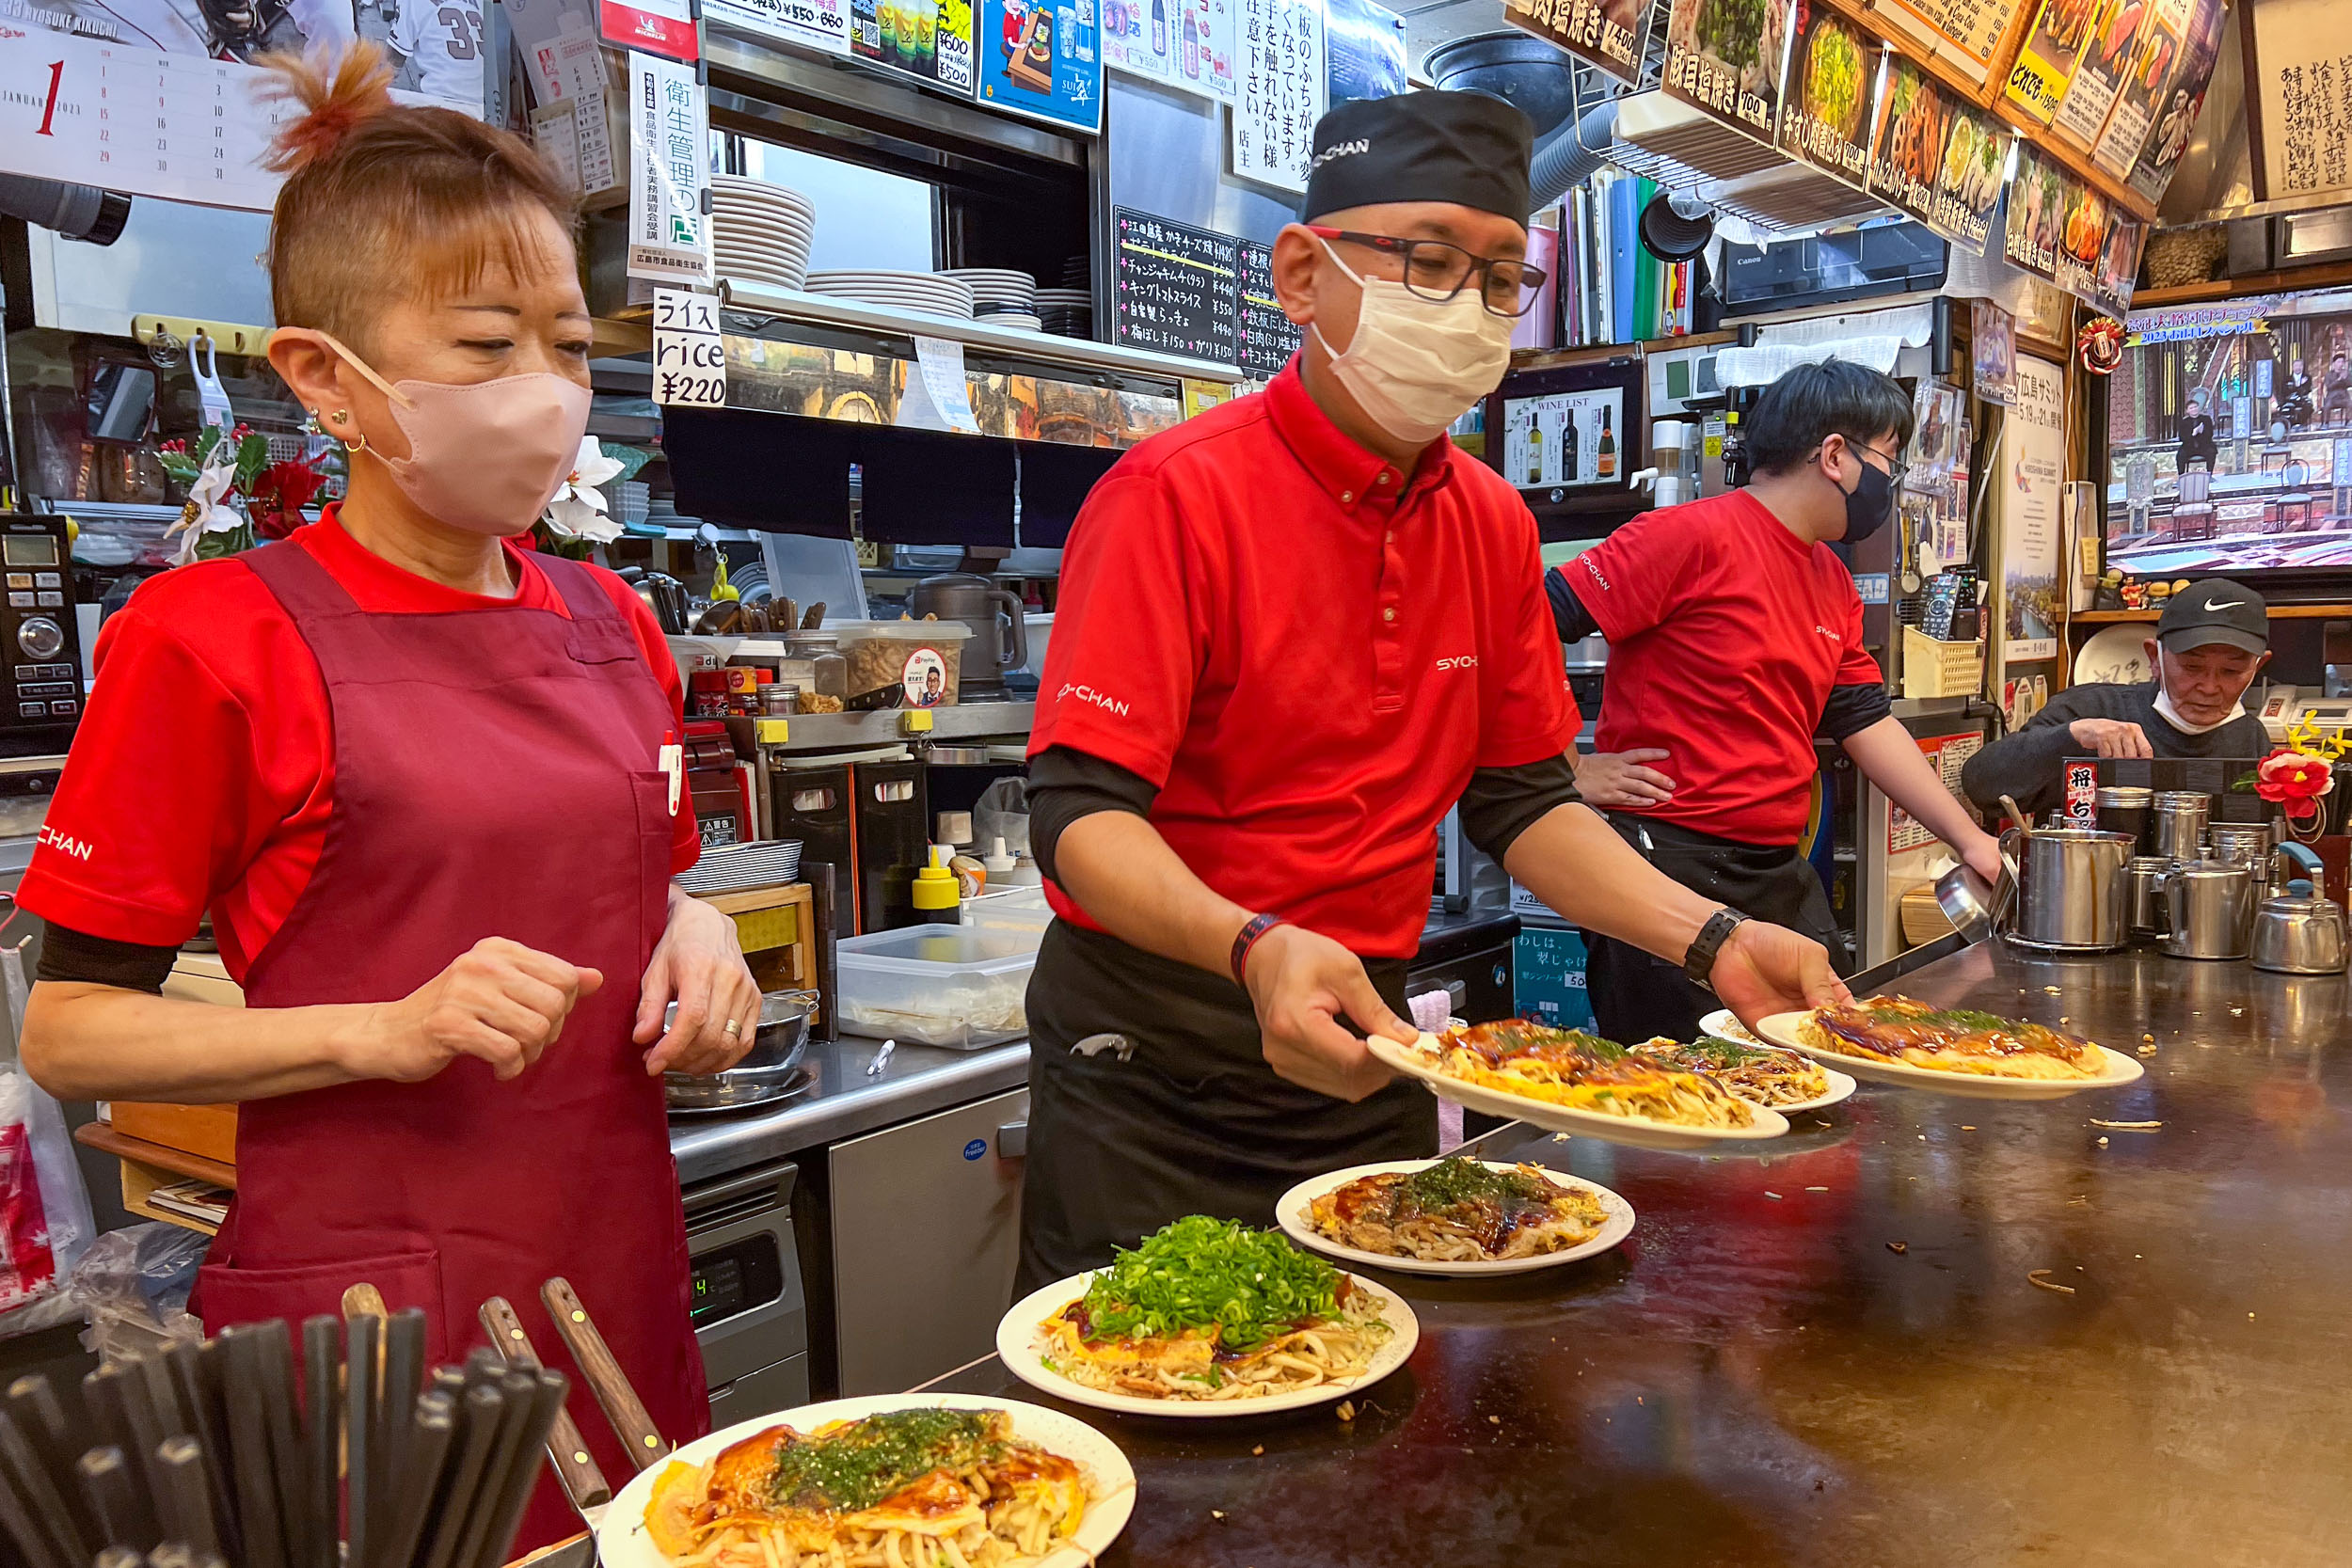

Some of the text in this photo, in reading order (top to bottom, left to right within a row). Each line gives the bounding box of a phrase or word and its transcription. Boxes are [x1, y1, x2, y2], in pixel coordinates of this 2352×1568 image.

[26, 8, 72, 29] RYOSUKE
[74, 15, 118, 38] KIKUCHI
[939, 31, 968, 55] ¥600
[101, 66, 221, 96] 1 2 3
[939, 60, 967, 84] ¥500
[56, 100, 81, 115] 2023
[101, 87, 106, 98] 8
[159, 97, 165, 107] 9
[215, 105, 223, 117] 10
[1740, 92, 1761, 115] 700
[100, 108, 108, 119] 15
[157, 118, 167, 129] 16
[215, 126, 223, 138] 17
[100, 130, 224, 159] 22 23 24
[1239, 129, 1250, 168] 店主
[100, 150, 223, 180] 29 30 31
[664, 77, 697, 246] 衛生管理の店
[1737, 256, 1761, 266] Canon
[659, 294, 715, 330] ライス
[1129, 278, 1233, 316] キングトマトスライス ¥550
[1161, 330, 1185, 350] ¥150
[1214, 341, 1233, 358] ¥150
[2140, 329, 2168, 344] 2023
[657, 337, 725, 368] rice
[660, 372, 726, 404] ¥220
[1537, 397, 1590, 411] WINE LIST
